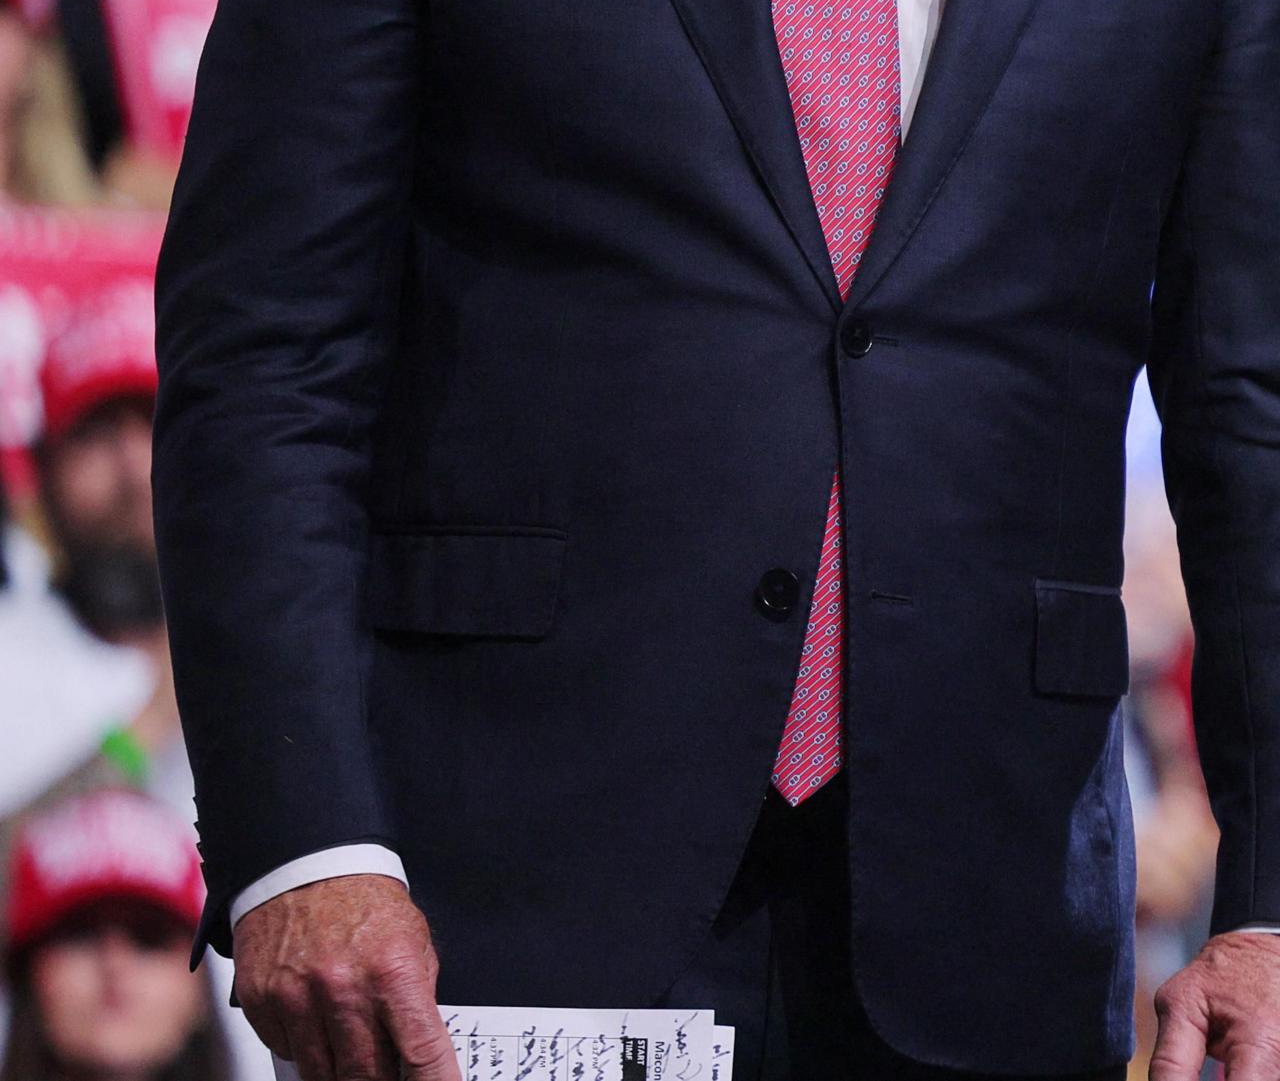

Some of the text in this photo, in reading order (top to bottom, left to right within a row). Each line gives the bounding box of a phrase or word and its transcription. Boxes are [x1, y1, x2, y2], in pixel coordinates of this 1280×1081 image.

[624, 1040, 634, 1061] TIME
[636, 1040, 645, 1066] START
[653, 1041, 665, 1081] Macon
